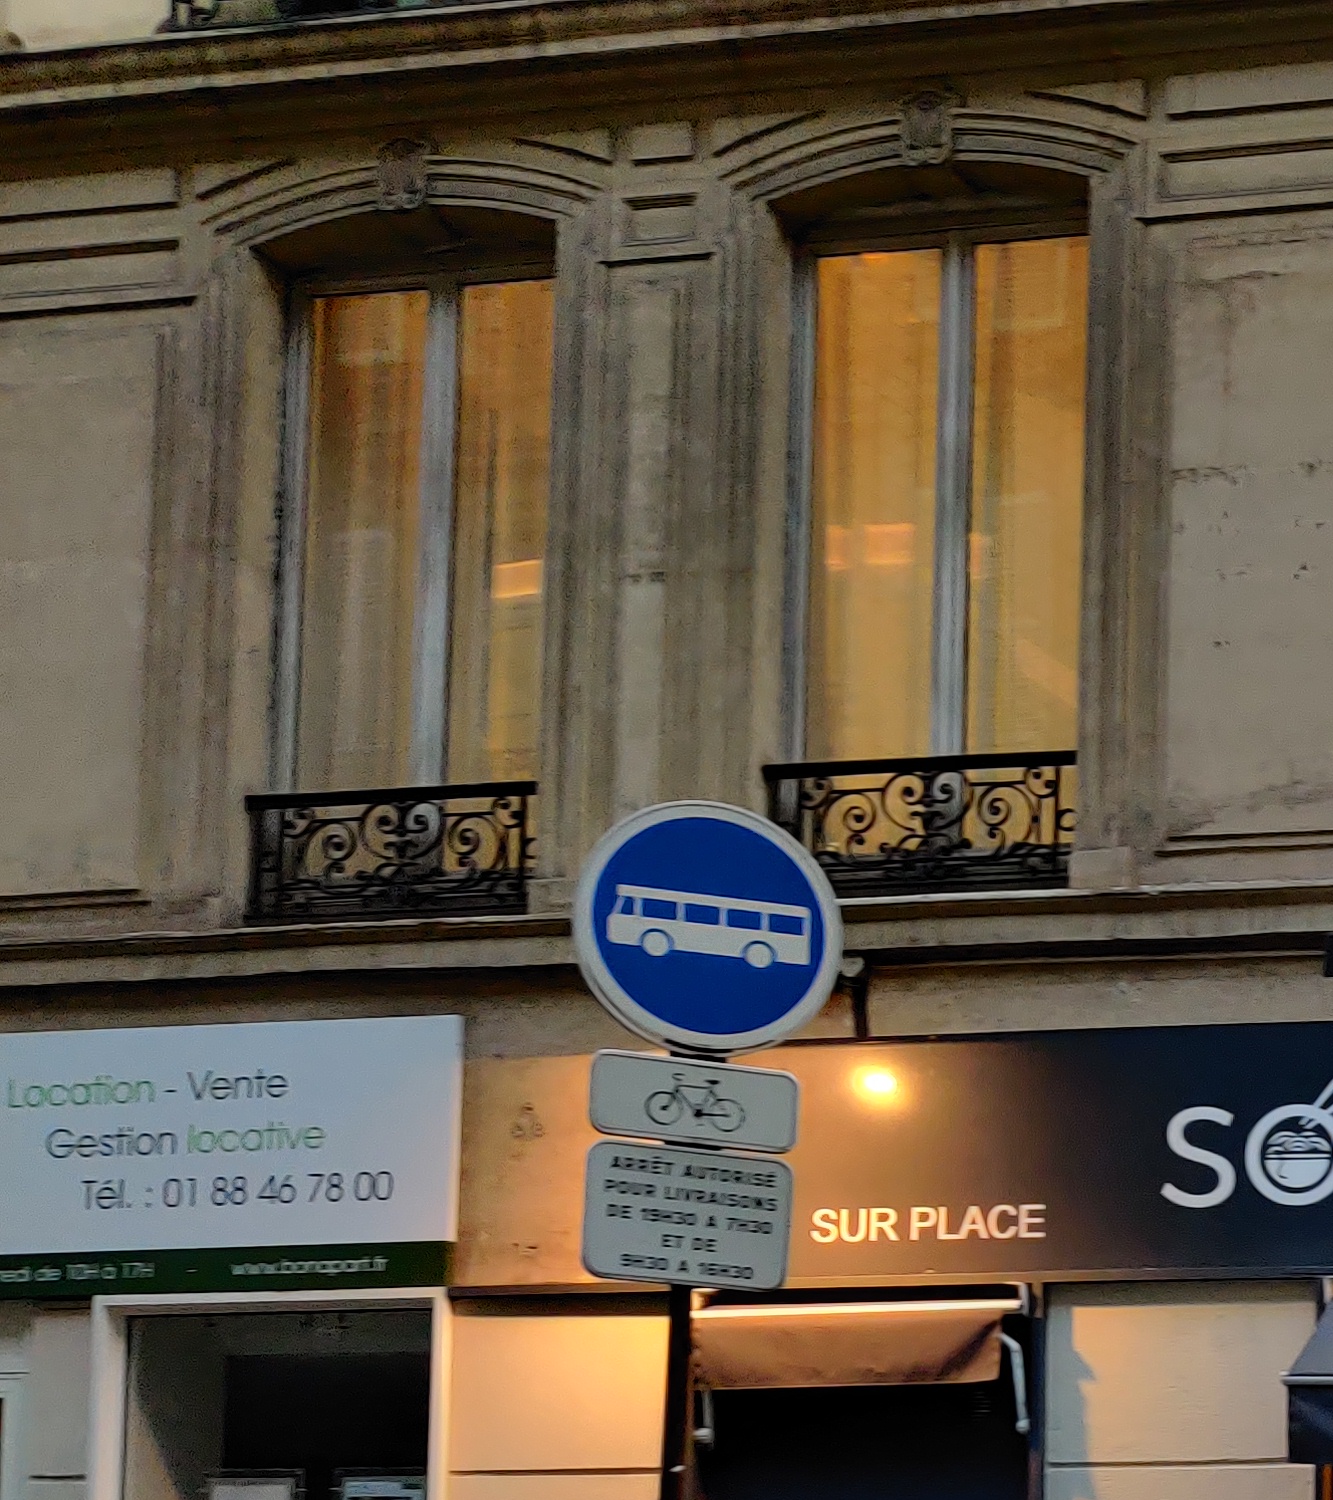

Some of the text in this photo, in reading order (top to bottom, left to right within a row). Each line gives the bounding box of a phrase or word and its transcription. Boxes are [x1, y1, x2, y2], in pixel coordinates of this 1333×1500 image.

[8, 1075, 156, 1108] Location
[186, 1068, 289, 1100] Vente
[46, 1121, 327, 1159] Gestion locative
[81, 1177, 132, 1210] Tél.
[162, 1177, 198, 1208] 01
[210, 1175, 248, 1206] 88
[256, 1174, 297, 1204] 46
[307, 1172, 344, 1202] 78
[353, 1171, 395, 1201] 00
[604, 1178, 778, 1211] POUR LIVRAISONS
[606, 1203, 633, 1219] DE
[809, 1204, 1047, 1243] SUR PLACE
[661, 1233, 718, 1252] ET DE
